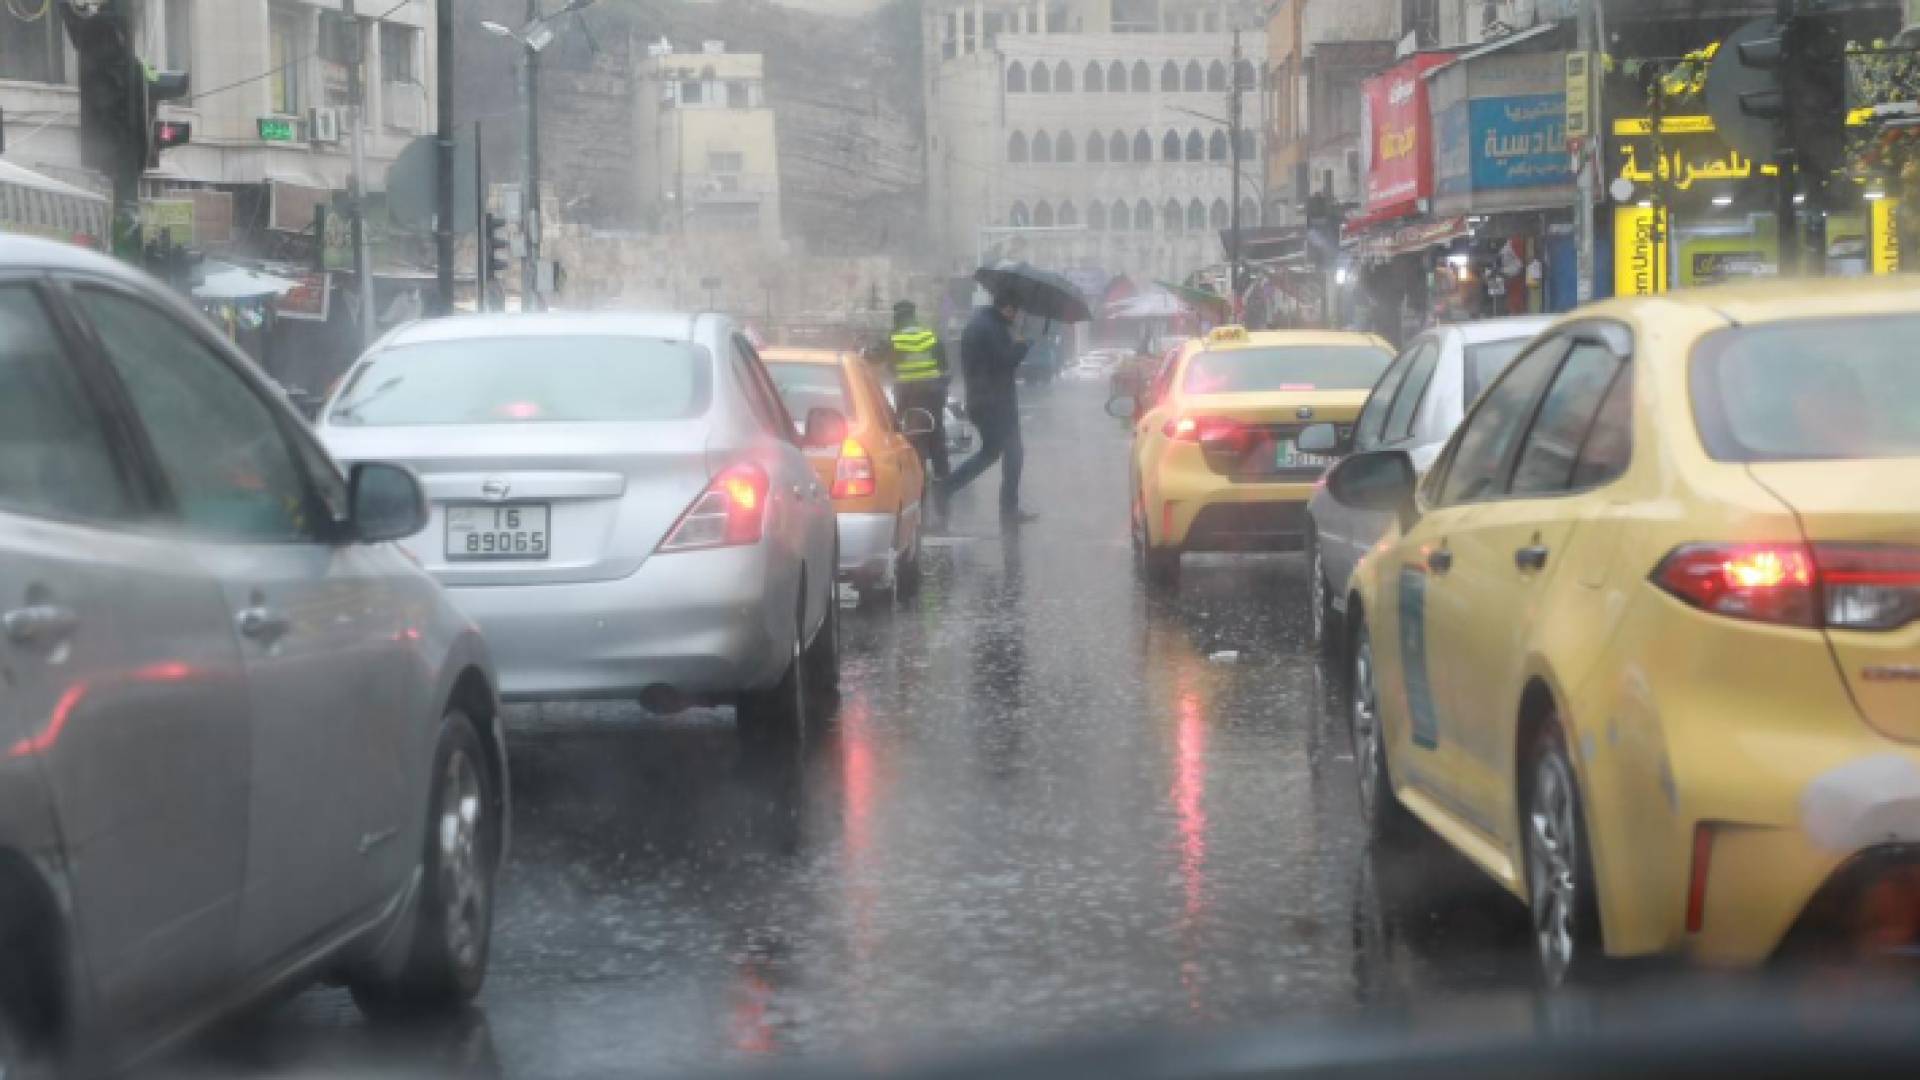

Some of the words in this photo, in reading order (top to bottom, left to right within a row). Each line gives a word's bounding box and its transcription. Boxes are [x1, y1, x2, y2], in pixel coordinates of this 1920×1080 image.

[1631, 215, 1648, 271] Union
[494, 509, 520, 529] 16
[467, 532, 544, 552] 89065
